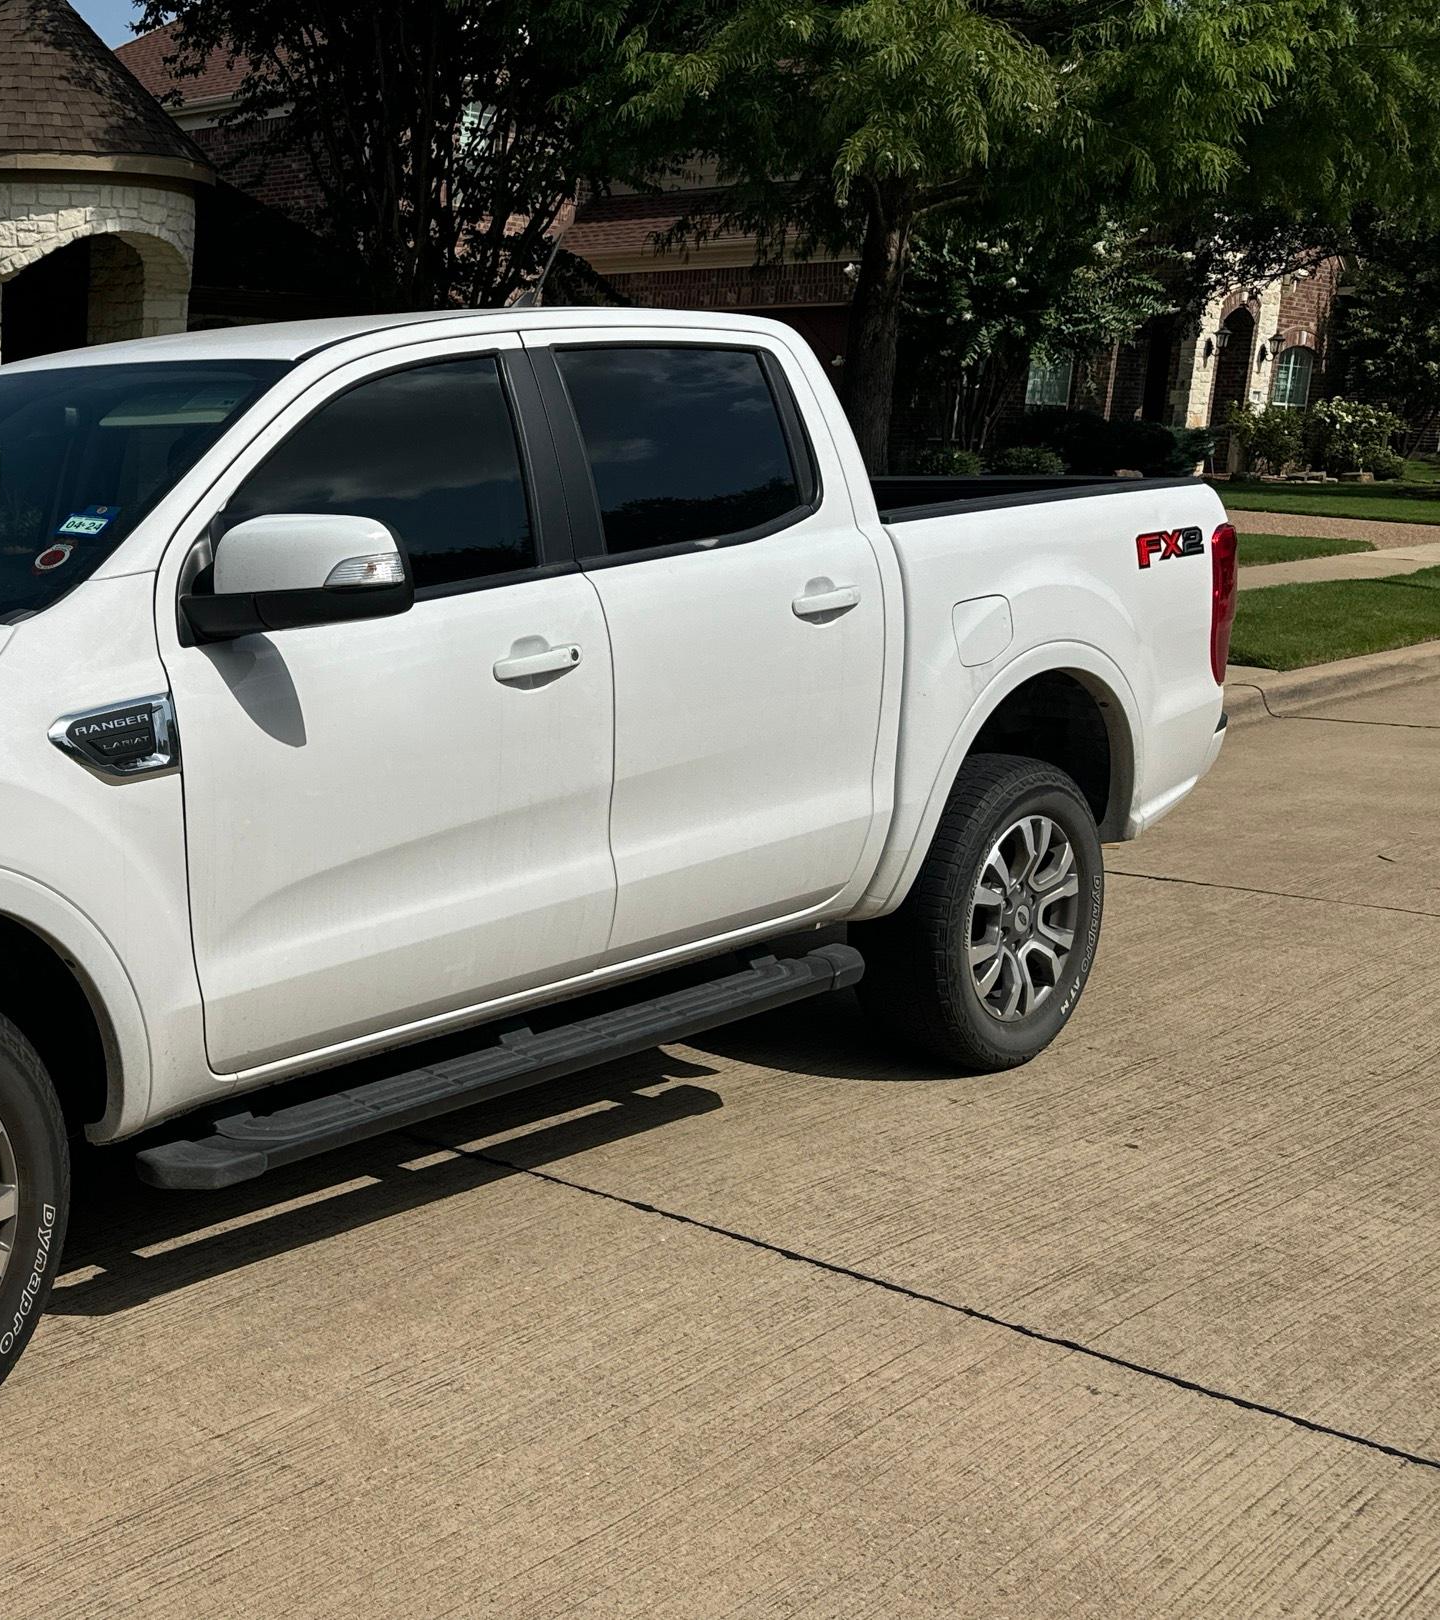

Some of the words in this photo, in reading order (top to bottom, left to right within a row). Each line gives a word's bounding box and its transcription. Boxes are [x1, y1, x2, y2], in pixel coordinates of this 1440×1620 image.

[1135, 525, 1205, 570] FX2
[74, 713, 149, 736] RANGER
[103, 735, 149, 750] LARIAT
